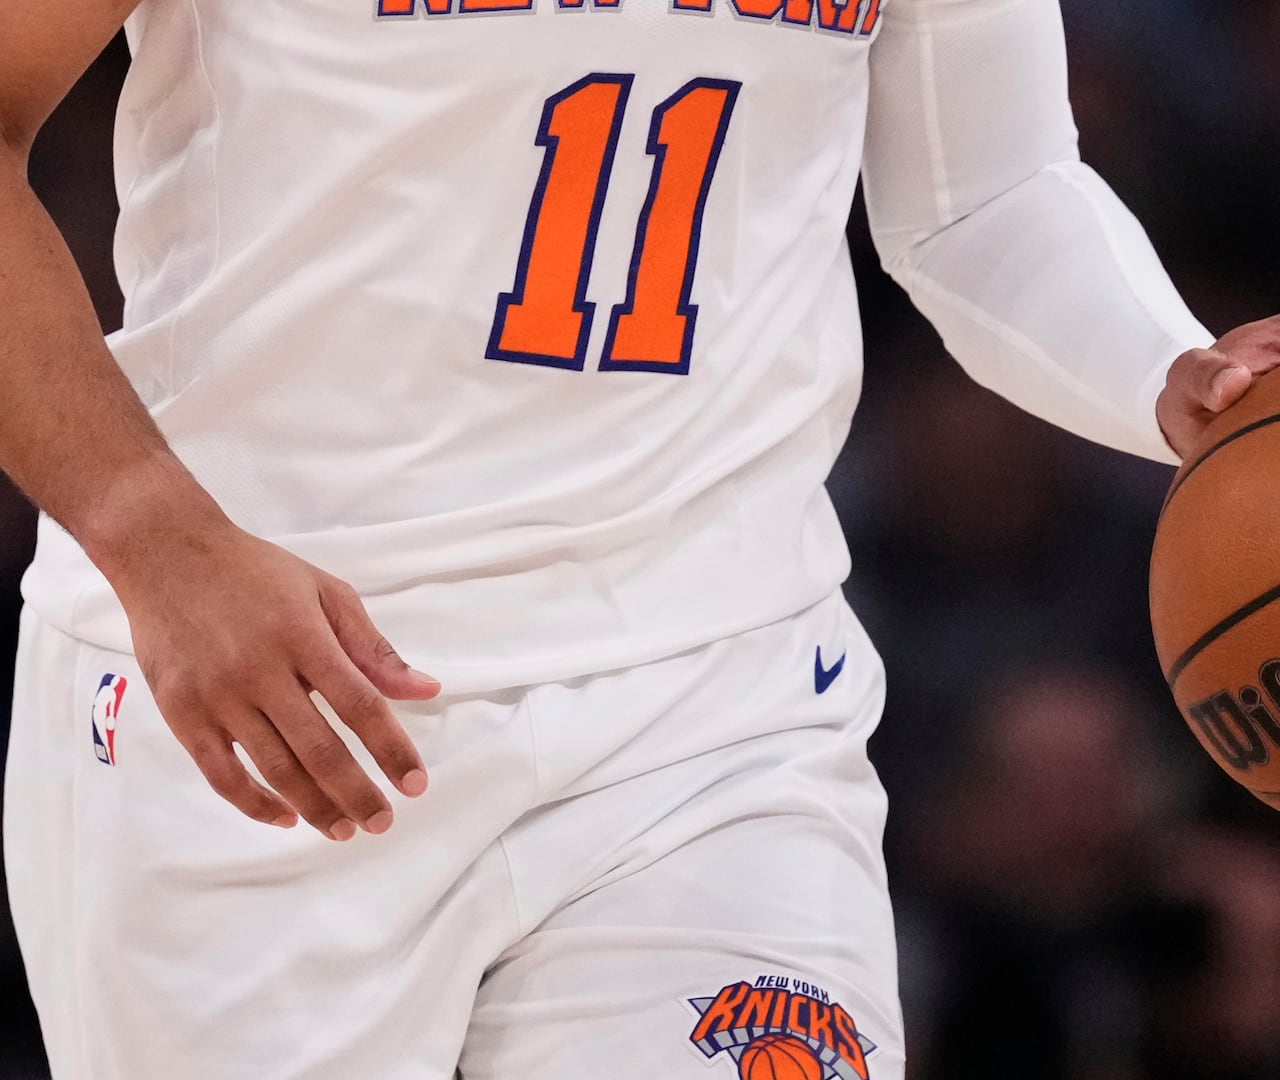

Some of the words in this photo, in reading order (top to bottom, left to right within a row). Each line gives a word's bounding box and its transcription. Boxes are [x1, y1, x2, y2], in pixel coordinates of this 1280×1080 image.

[485, 73, 742, 374] 11
[689, 980, 871, 1080] KNICKS
[754, 975, 789, 989] NEW
[793, 978, 830, 1003] YORK
